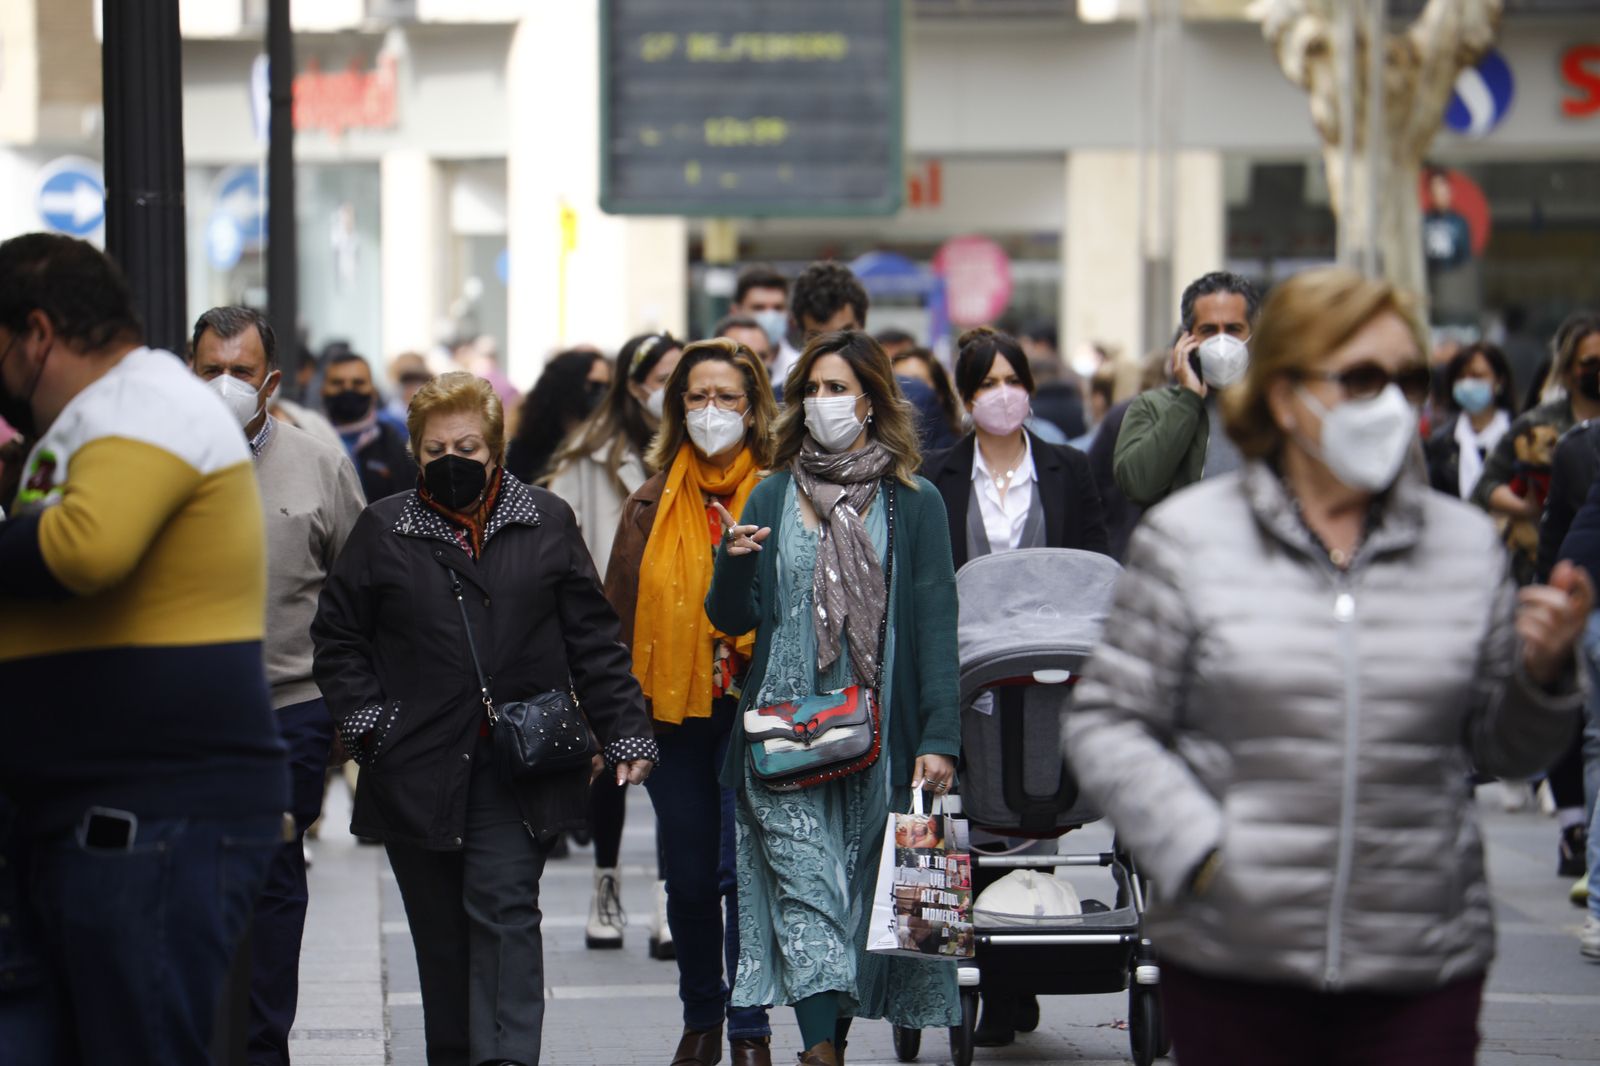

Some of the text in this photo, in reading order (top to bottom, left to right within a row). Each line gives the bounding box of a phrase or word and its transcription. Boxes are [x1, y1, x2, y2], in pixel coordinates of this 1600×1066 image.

[919, 855, 931, 868] AT
[920, 889, 935, 904] ALL
[921, 907, 960, 923] MOMENTS
